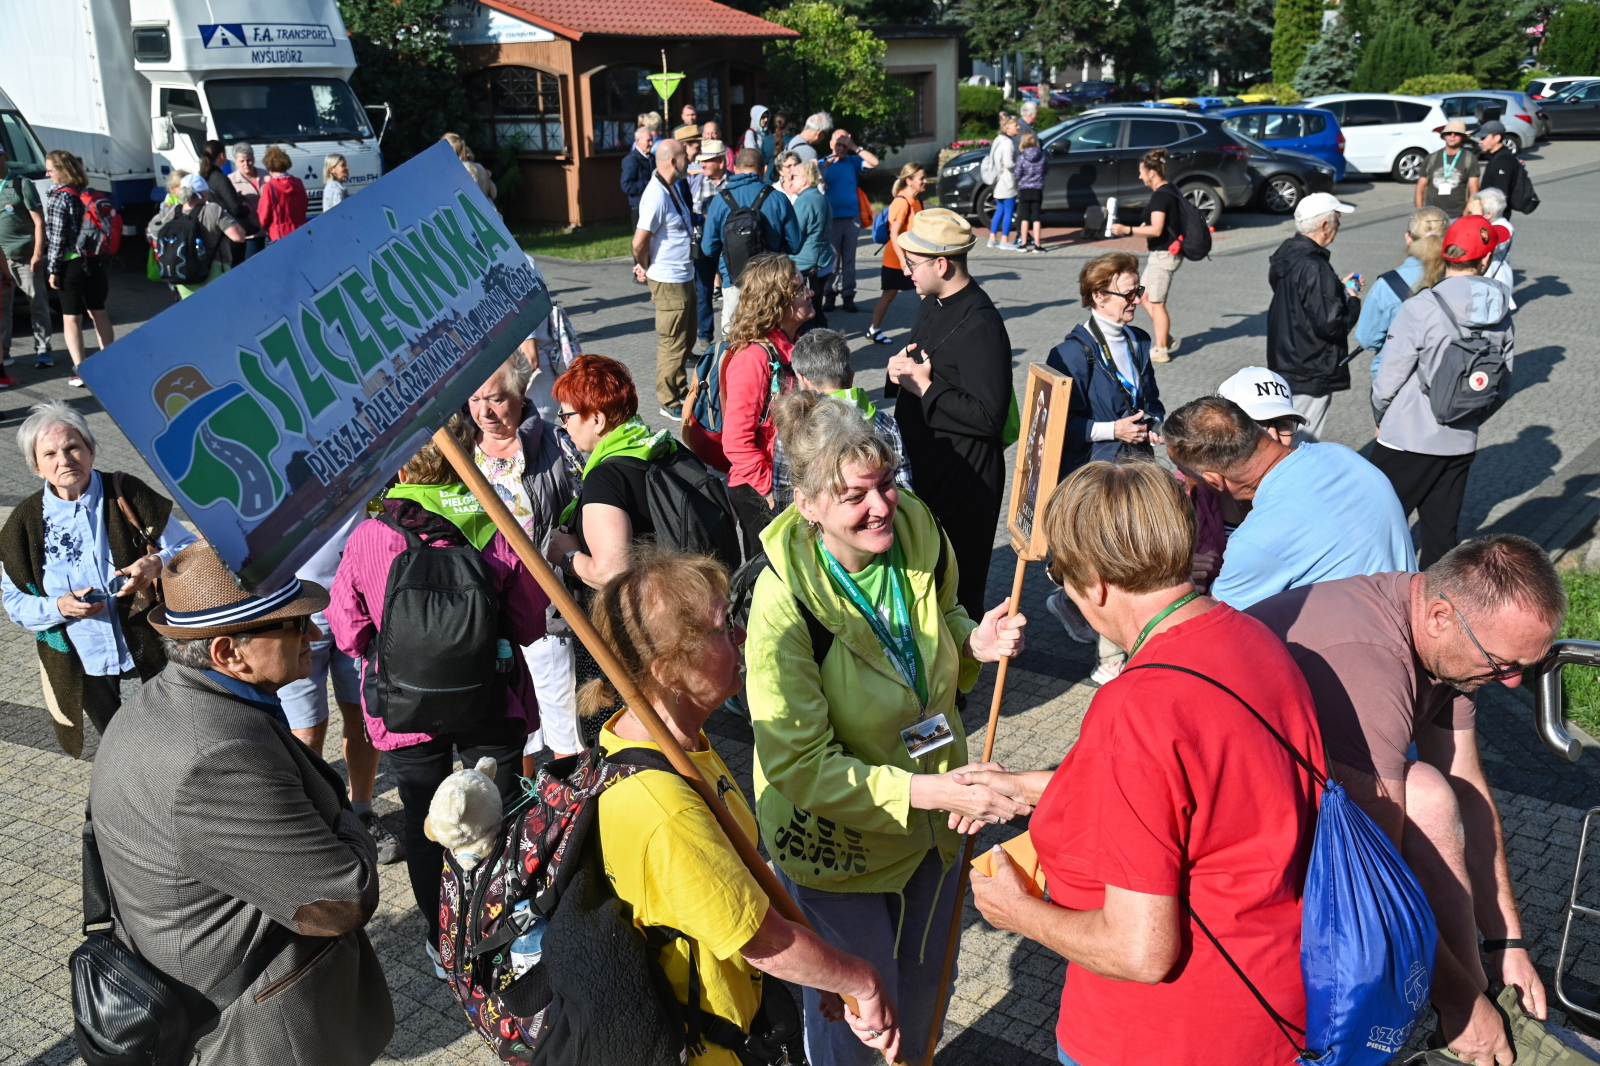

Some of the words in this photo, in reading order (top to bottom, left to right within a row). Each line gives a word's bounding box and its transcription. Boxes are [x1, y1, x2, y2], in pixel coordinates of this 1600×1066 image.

[253, 27, 274, 42] F.A.
[277, 29, 327, 40] TRANSPORT
[252, 47, 303, 63] MYŚLIBÓRZ
[343, 176, 365, 184] NTER
[238, 190, 512, 436] SZCZECIŃSKA
[304, 416, 378, 487] PIESZA
[362, 330, 466, 435] PIELGRZYMKA
[453, 312, 484, 351] NA
[473, 284, 520, 334] JASNĄ
[506, 262, 542, 302] GÓRĘ
[1254, 381, 1290, 399] NYC
[808, 815, 842, 876] big.
[1366, 1041, 1392, 1054] PIESZA
